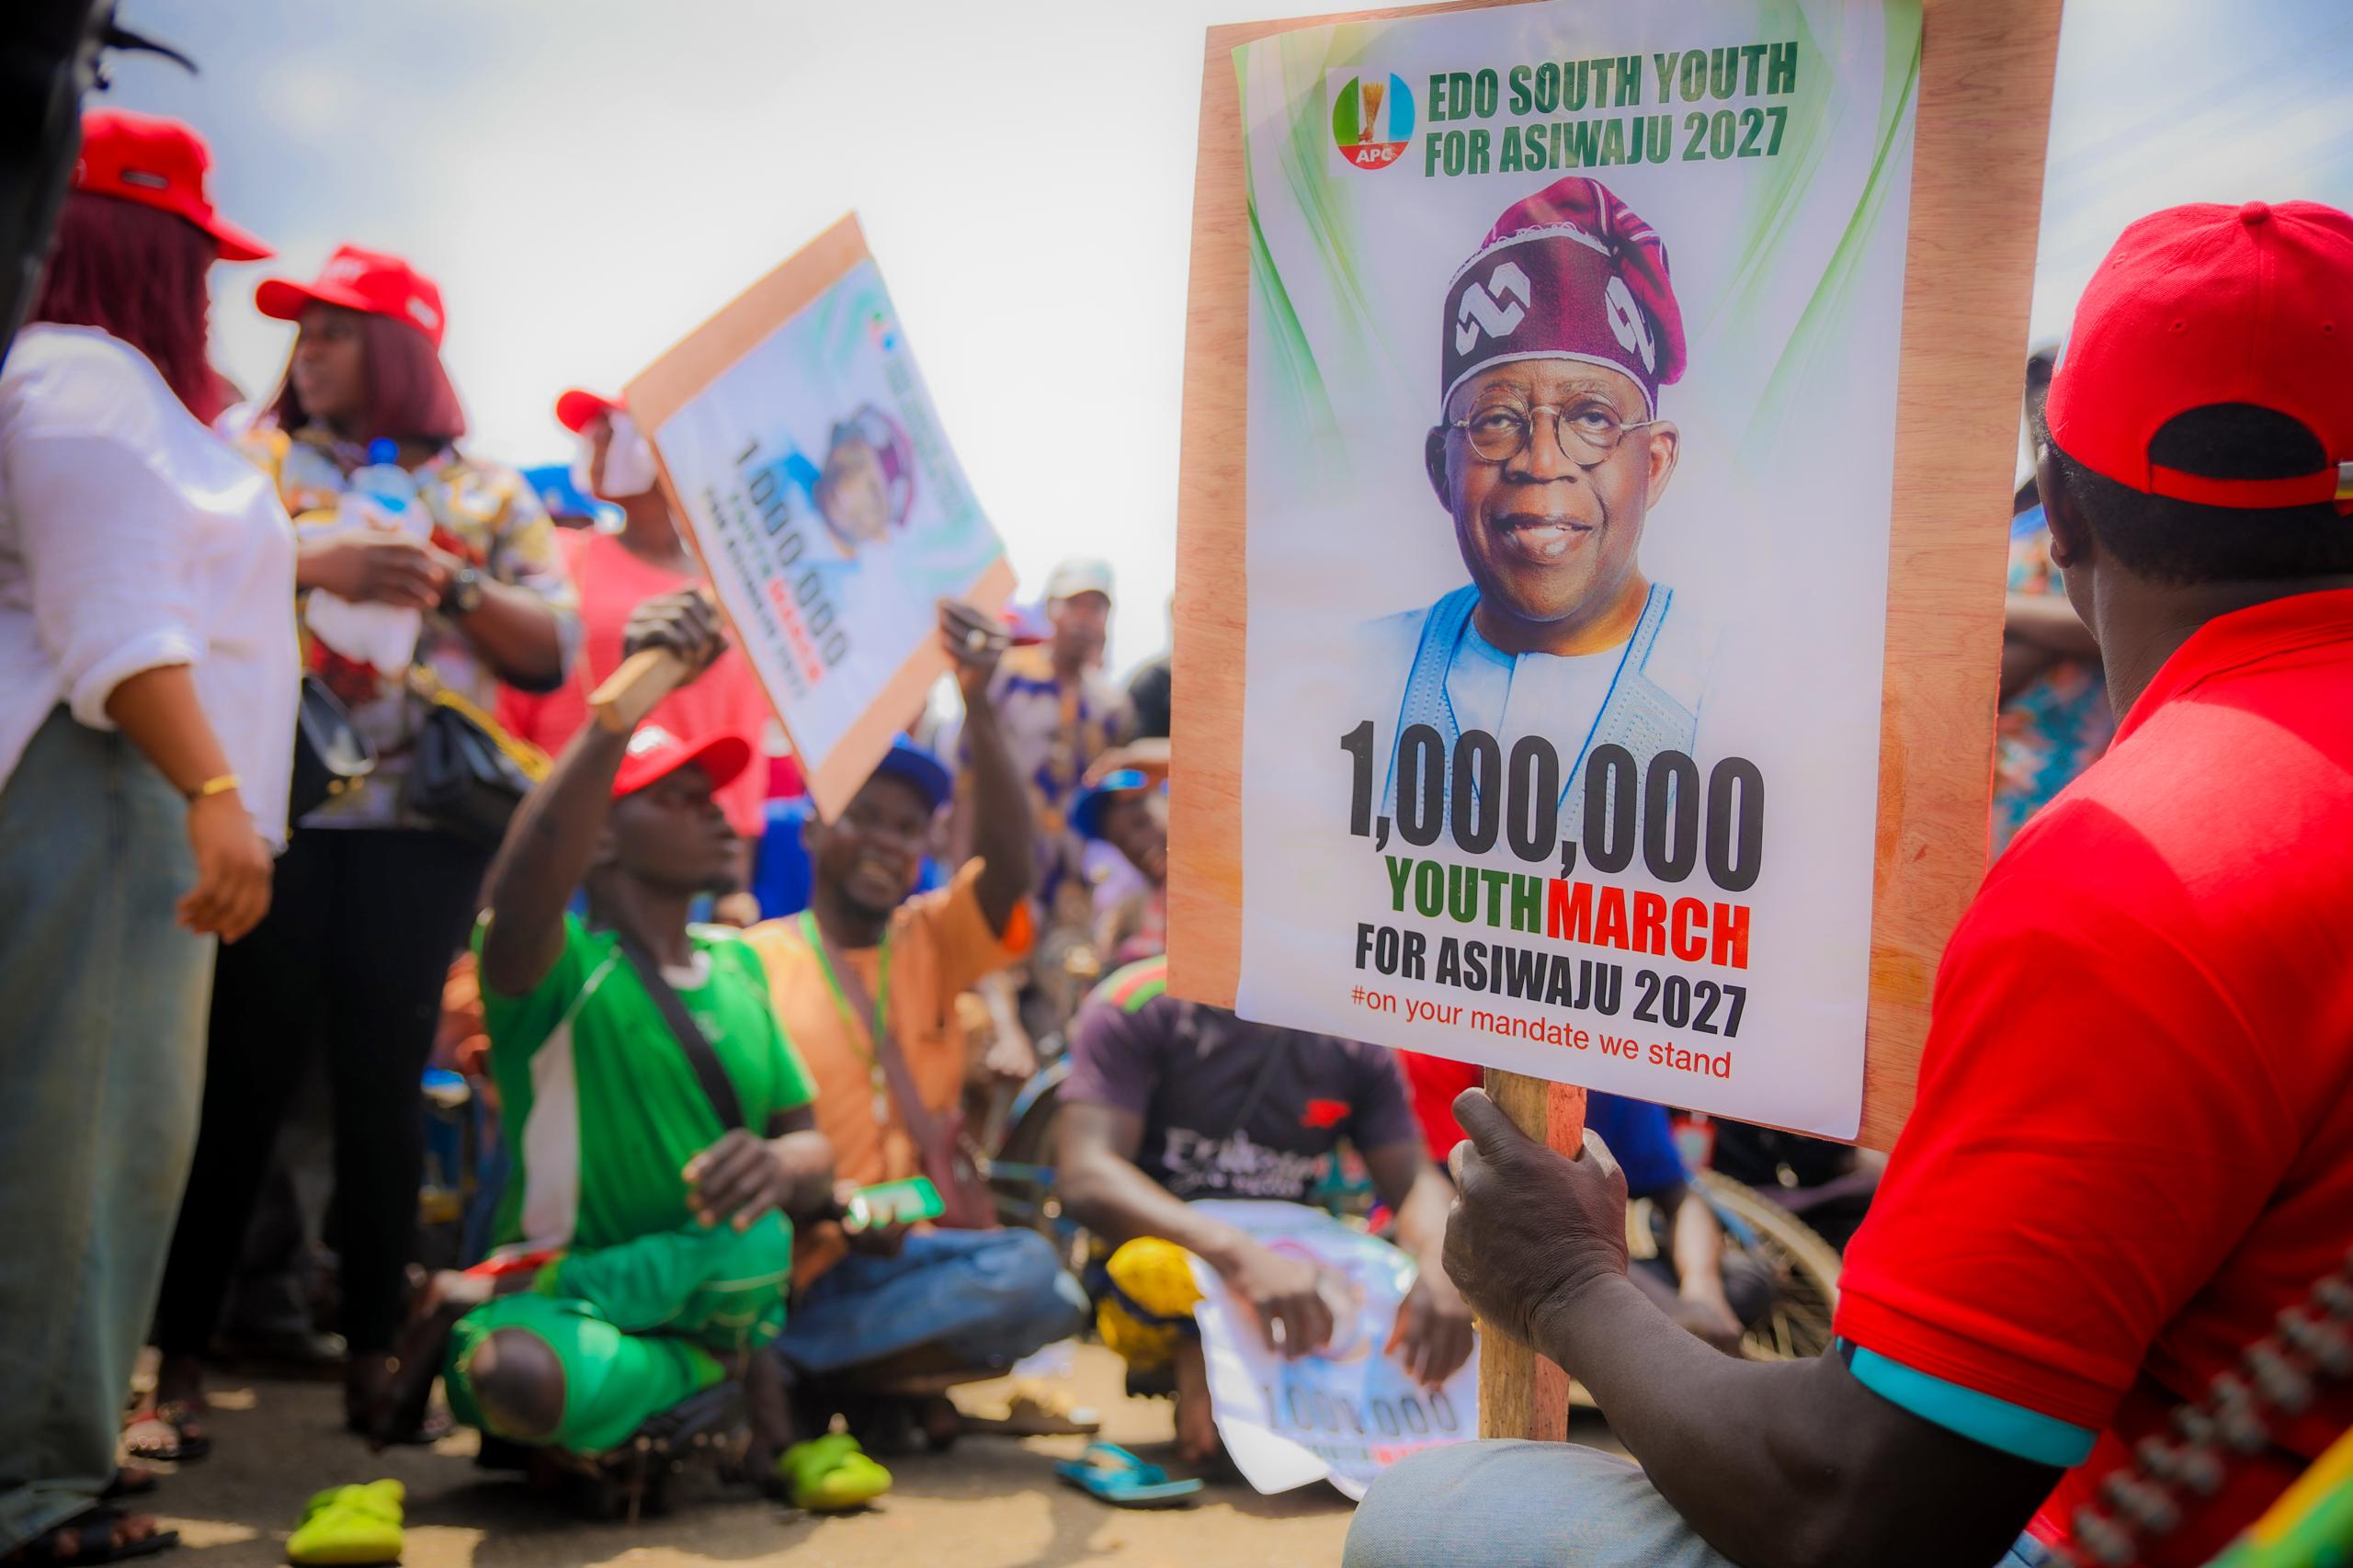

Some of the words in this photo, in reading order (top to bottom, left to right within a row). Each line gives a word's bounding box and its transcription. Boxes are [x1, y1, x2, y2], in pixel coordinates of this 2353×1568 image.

[1428, 66, 1499, 122] EDO
[1508, 54, 1643, 116] SOUTH
[1654, 36, 1800, 105] YOUTH
[1356, 146, 1392, 163] APC
[1425, 129, 1491, 177] FOR
[1498, 113, 1673, 173] ASIWAJU
[1681, 105, 1790, 163] 2027
[1339, 720, 1766, 892] 1,000,000
[1355, 921, 1427, 982] FOR
[1435, 935, 1623, 1017] ASIWAJU
[1632, 969, 1748, 1040] 2027
[1351, 985, 1397, 1014] #on
[1404, 996, 1465, 1027] your
[1471, 1008, 1591, 1052] mandate
[1597, 1033, 1642, 1062] we
[1647, 1041, 1733, 1081] stand
